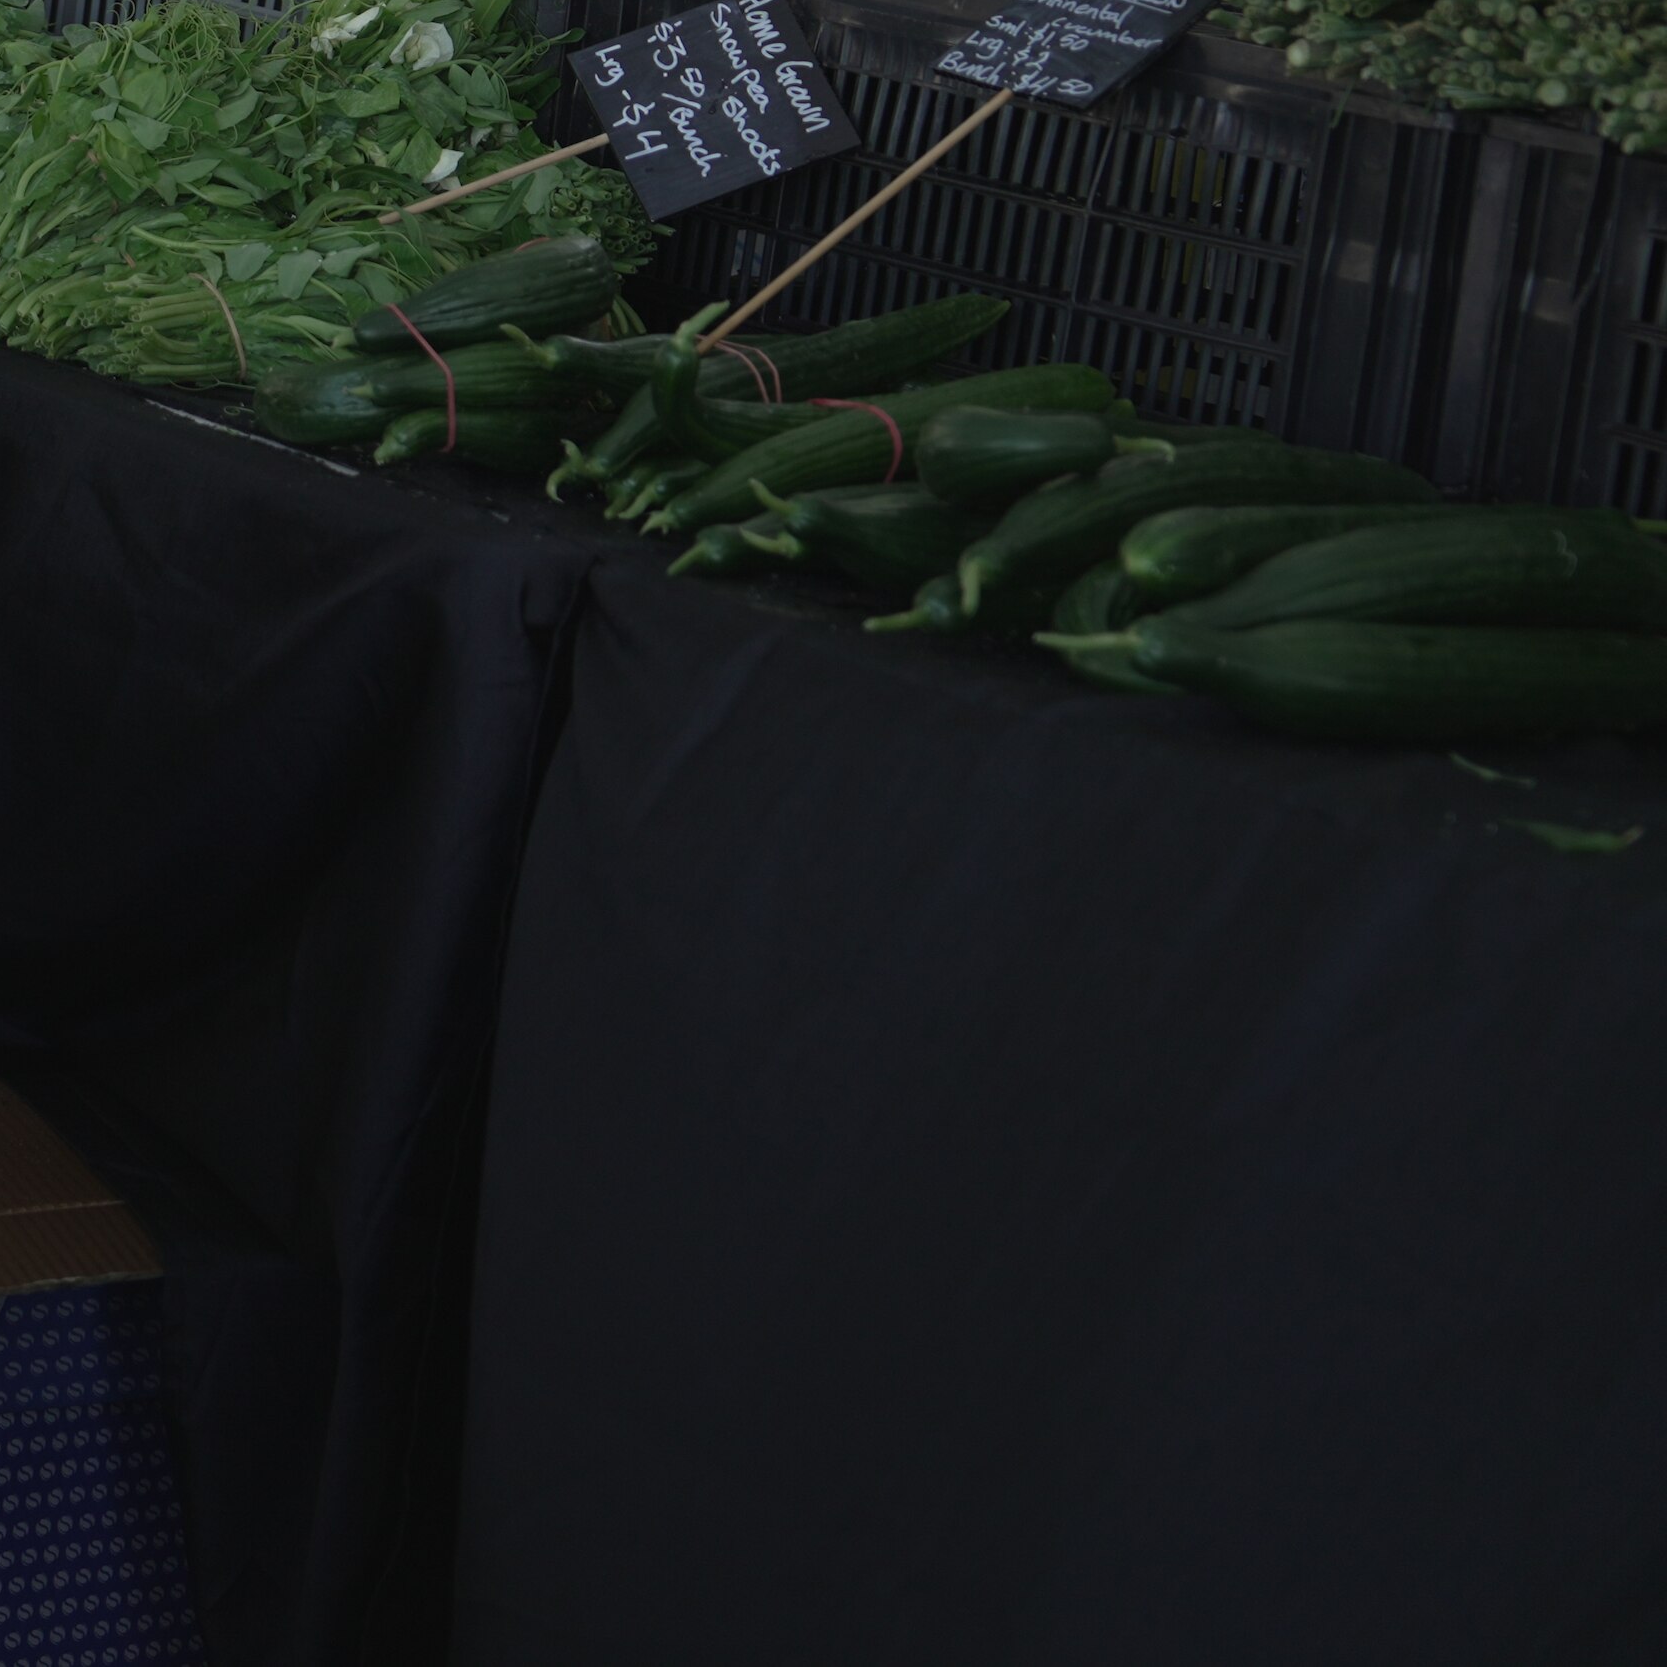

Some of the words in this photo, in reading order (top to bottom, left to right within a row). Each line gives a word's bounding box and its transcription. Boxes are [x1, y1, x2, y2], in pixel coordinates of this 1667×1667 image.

[1050, 16, 1164, 50] Cucumber
[594, 43, 626, 88] Lrg
[1013, 45, 1051, 72] $2
[775, 60, 831, 134] Grown
